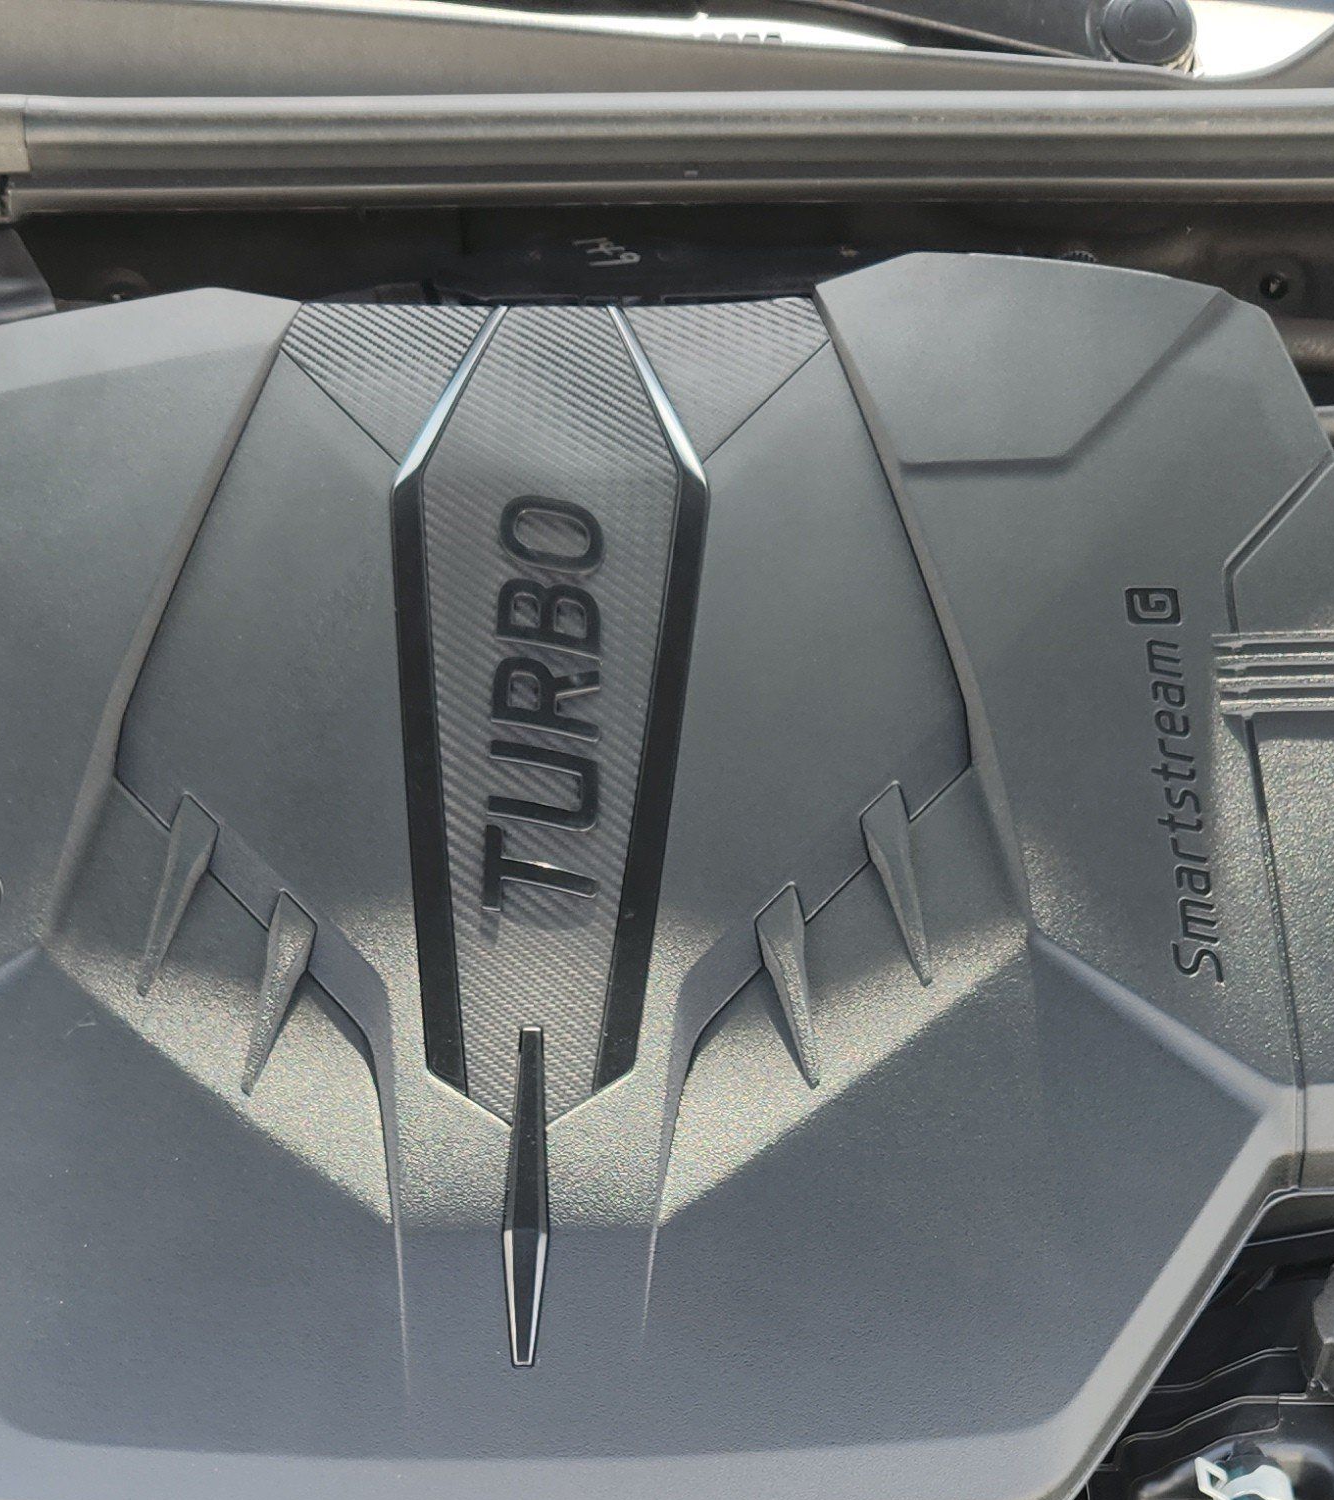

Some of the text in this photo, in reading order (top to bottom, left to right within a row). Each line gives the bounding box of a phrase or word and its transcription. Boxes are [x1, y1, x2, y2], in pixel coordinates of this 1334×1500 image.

[481, 493, 605, 914] TURBO
[1128, 588, 1227, 987] Smartstream G
